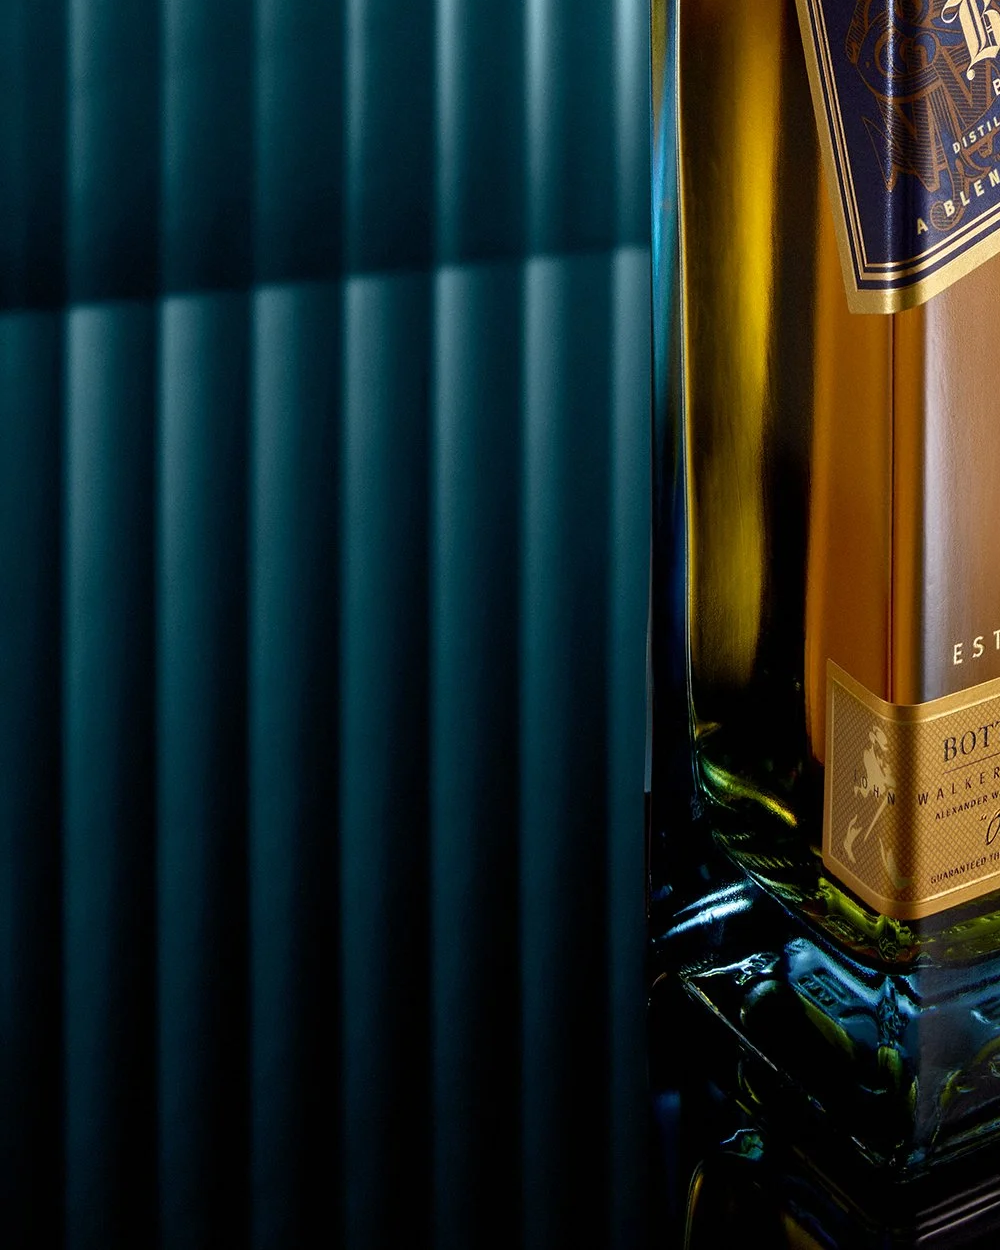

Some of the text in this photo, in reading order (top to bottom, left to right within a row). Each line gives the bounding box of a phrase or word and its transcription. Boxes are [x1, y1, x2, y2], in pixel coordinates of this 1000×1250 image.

[916, 217, 929, 235] A
[918, 766, 1000, 806] WALKER
[935, 794, 988, 820] ALEXANDER
[930, 857, 987, 885] GUARANTEED
